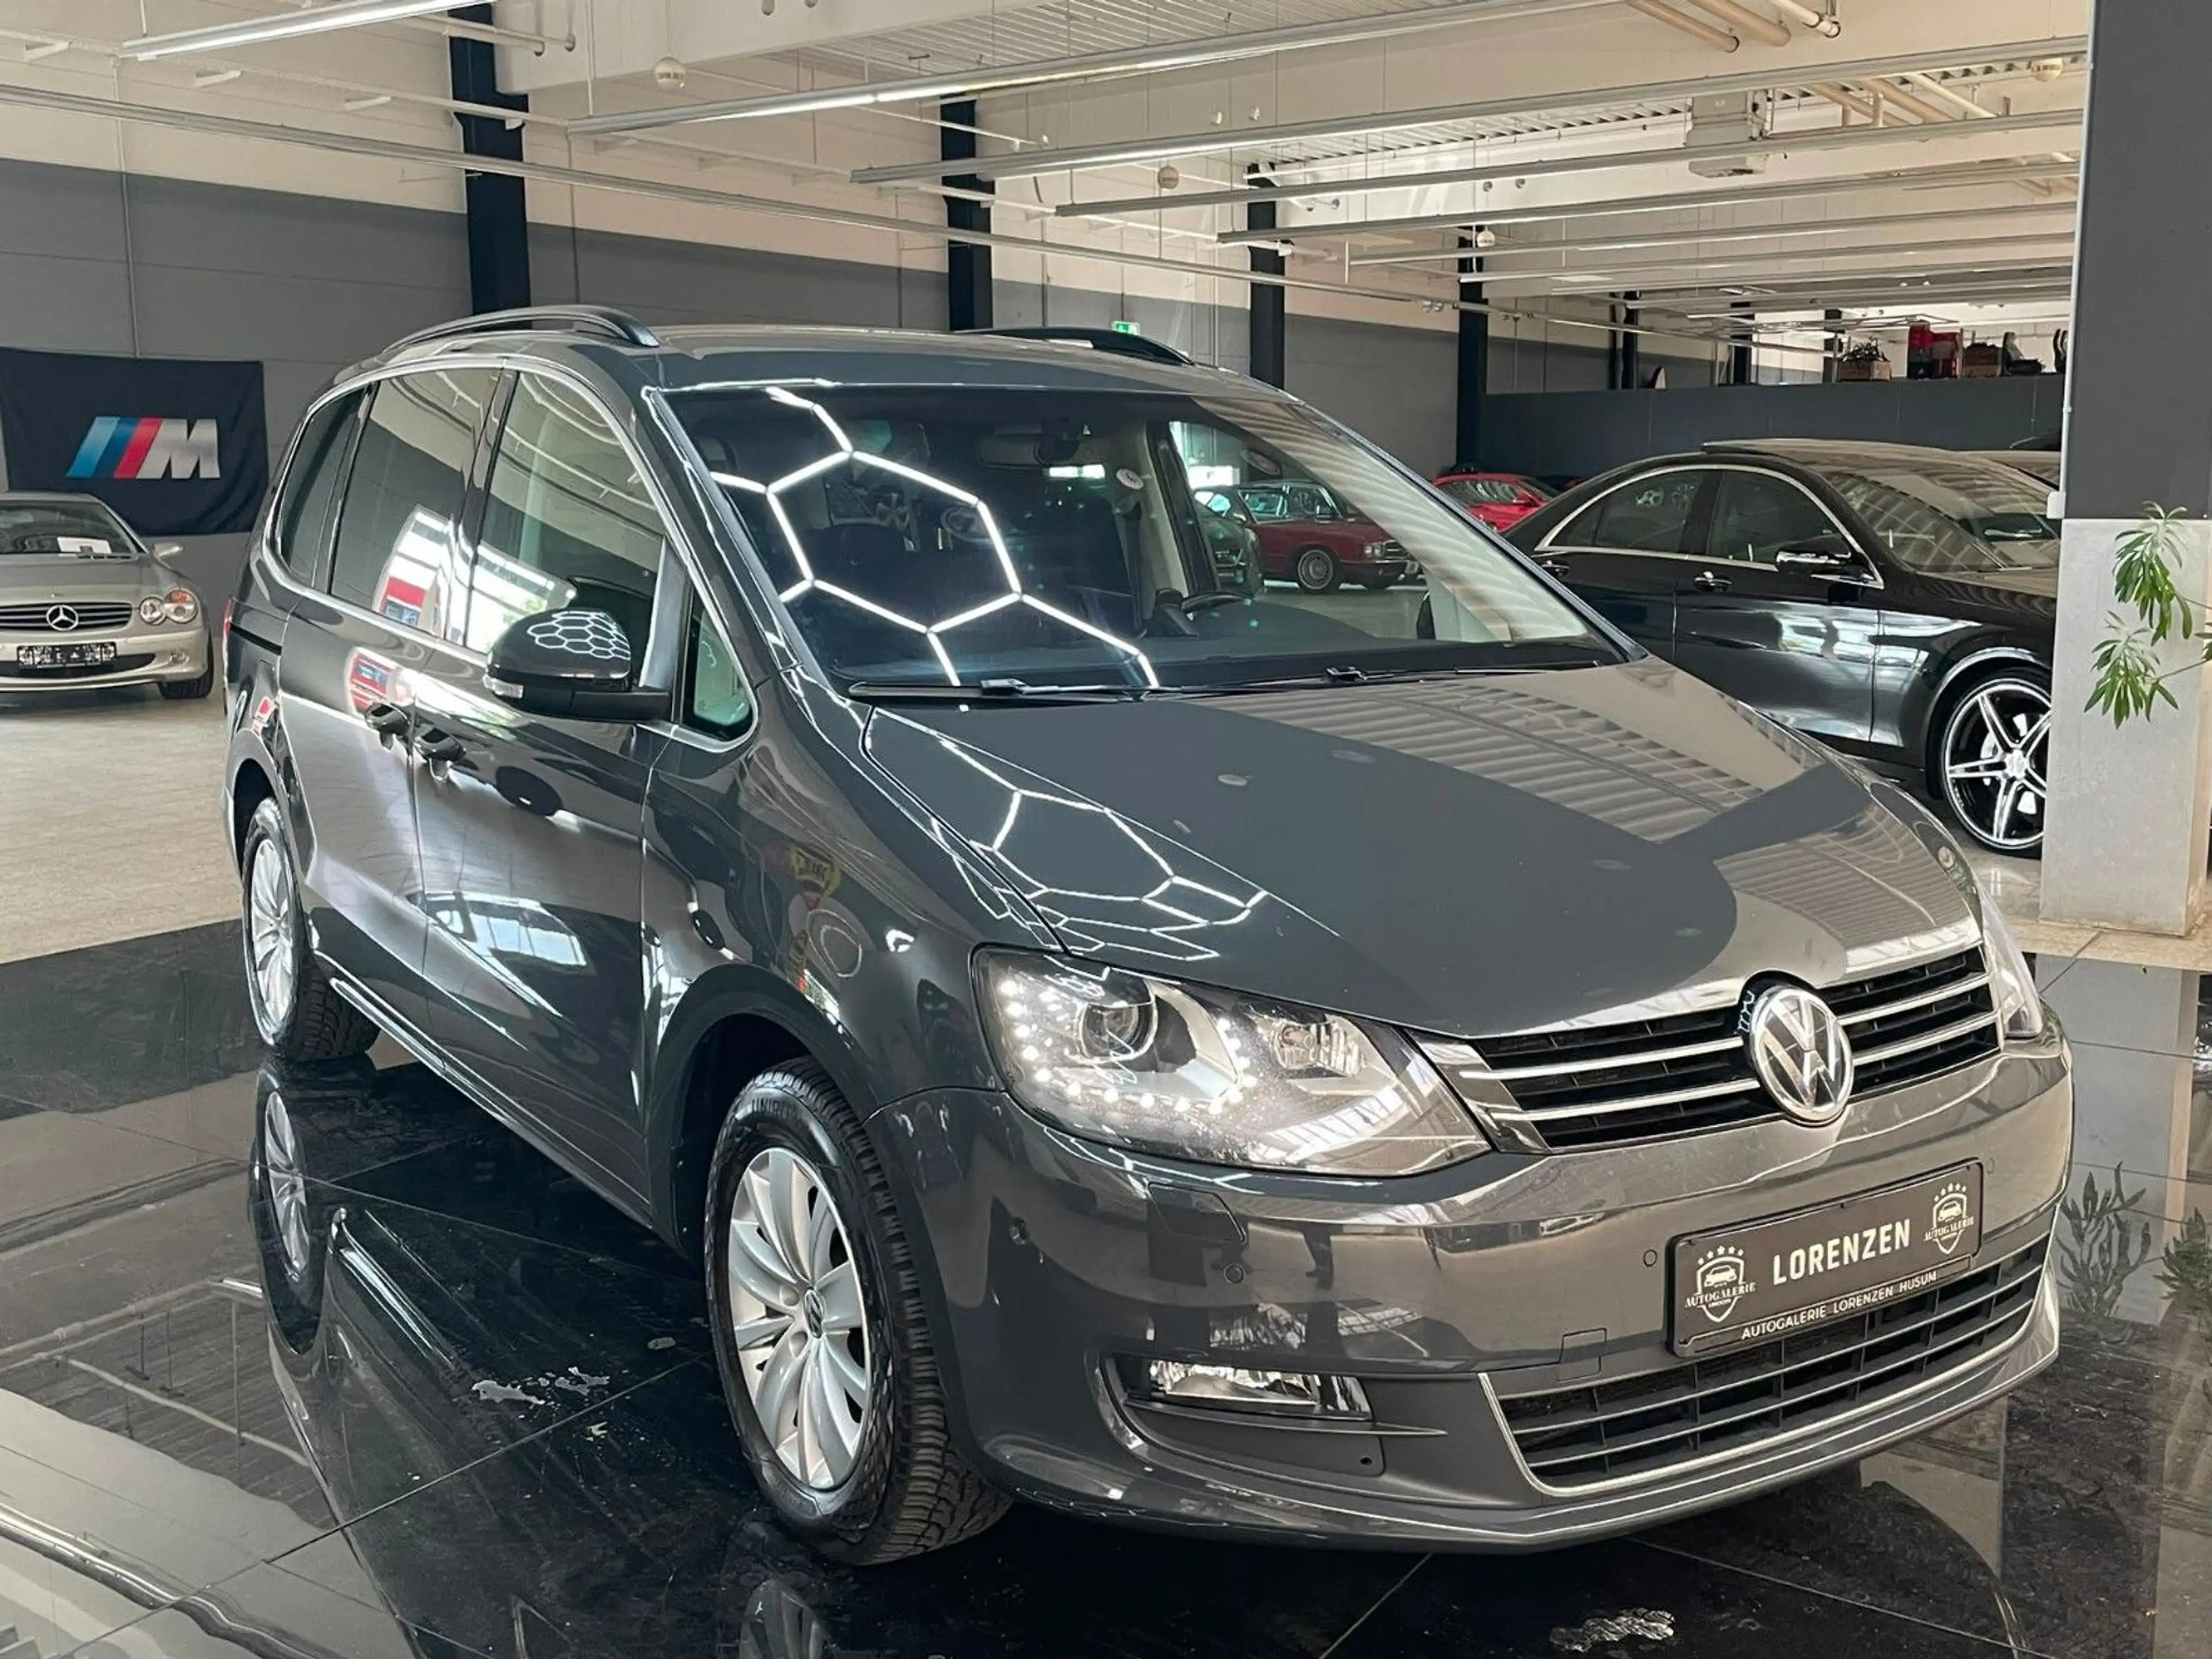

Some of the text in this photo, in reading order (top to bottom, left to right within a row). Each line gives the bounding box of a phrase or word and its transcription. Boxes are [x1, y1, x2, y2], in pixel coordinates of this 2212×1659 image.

[135, 418, 220, 479] M
[1773, 1218, 1910, 1285] LORENZEN
[1684, 1281, 1756, 1309] AUTOGALERIE
[1741, 1270, 1937, 1340] AUTOGALERIE LORENZEN HUSUM
